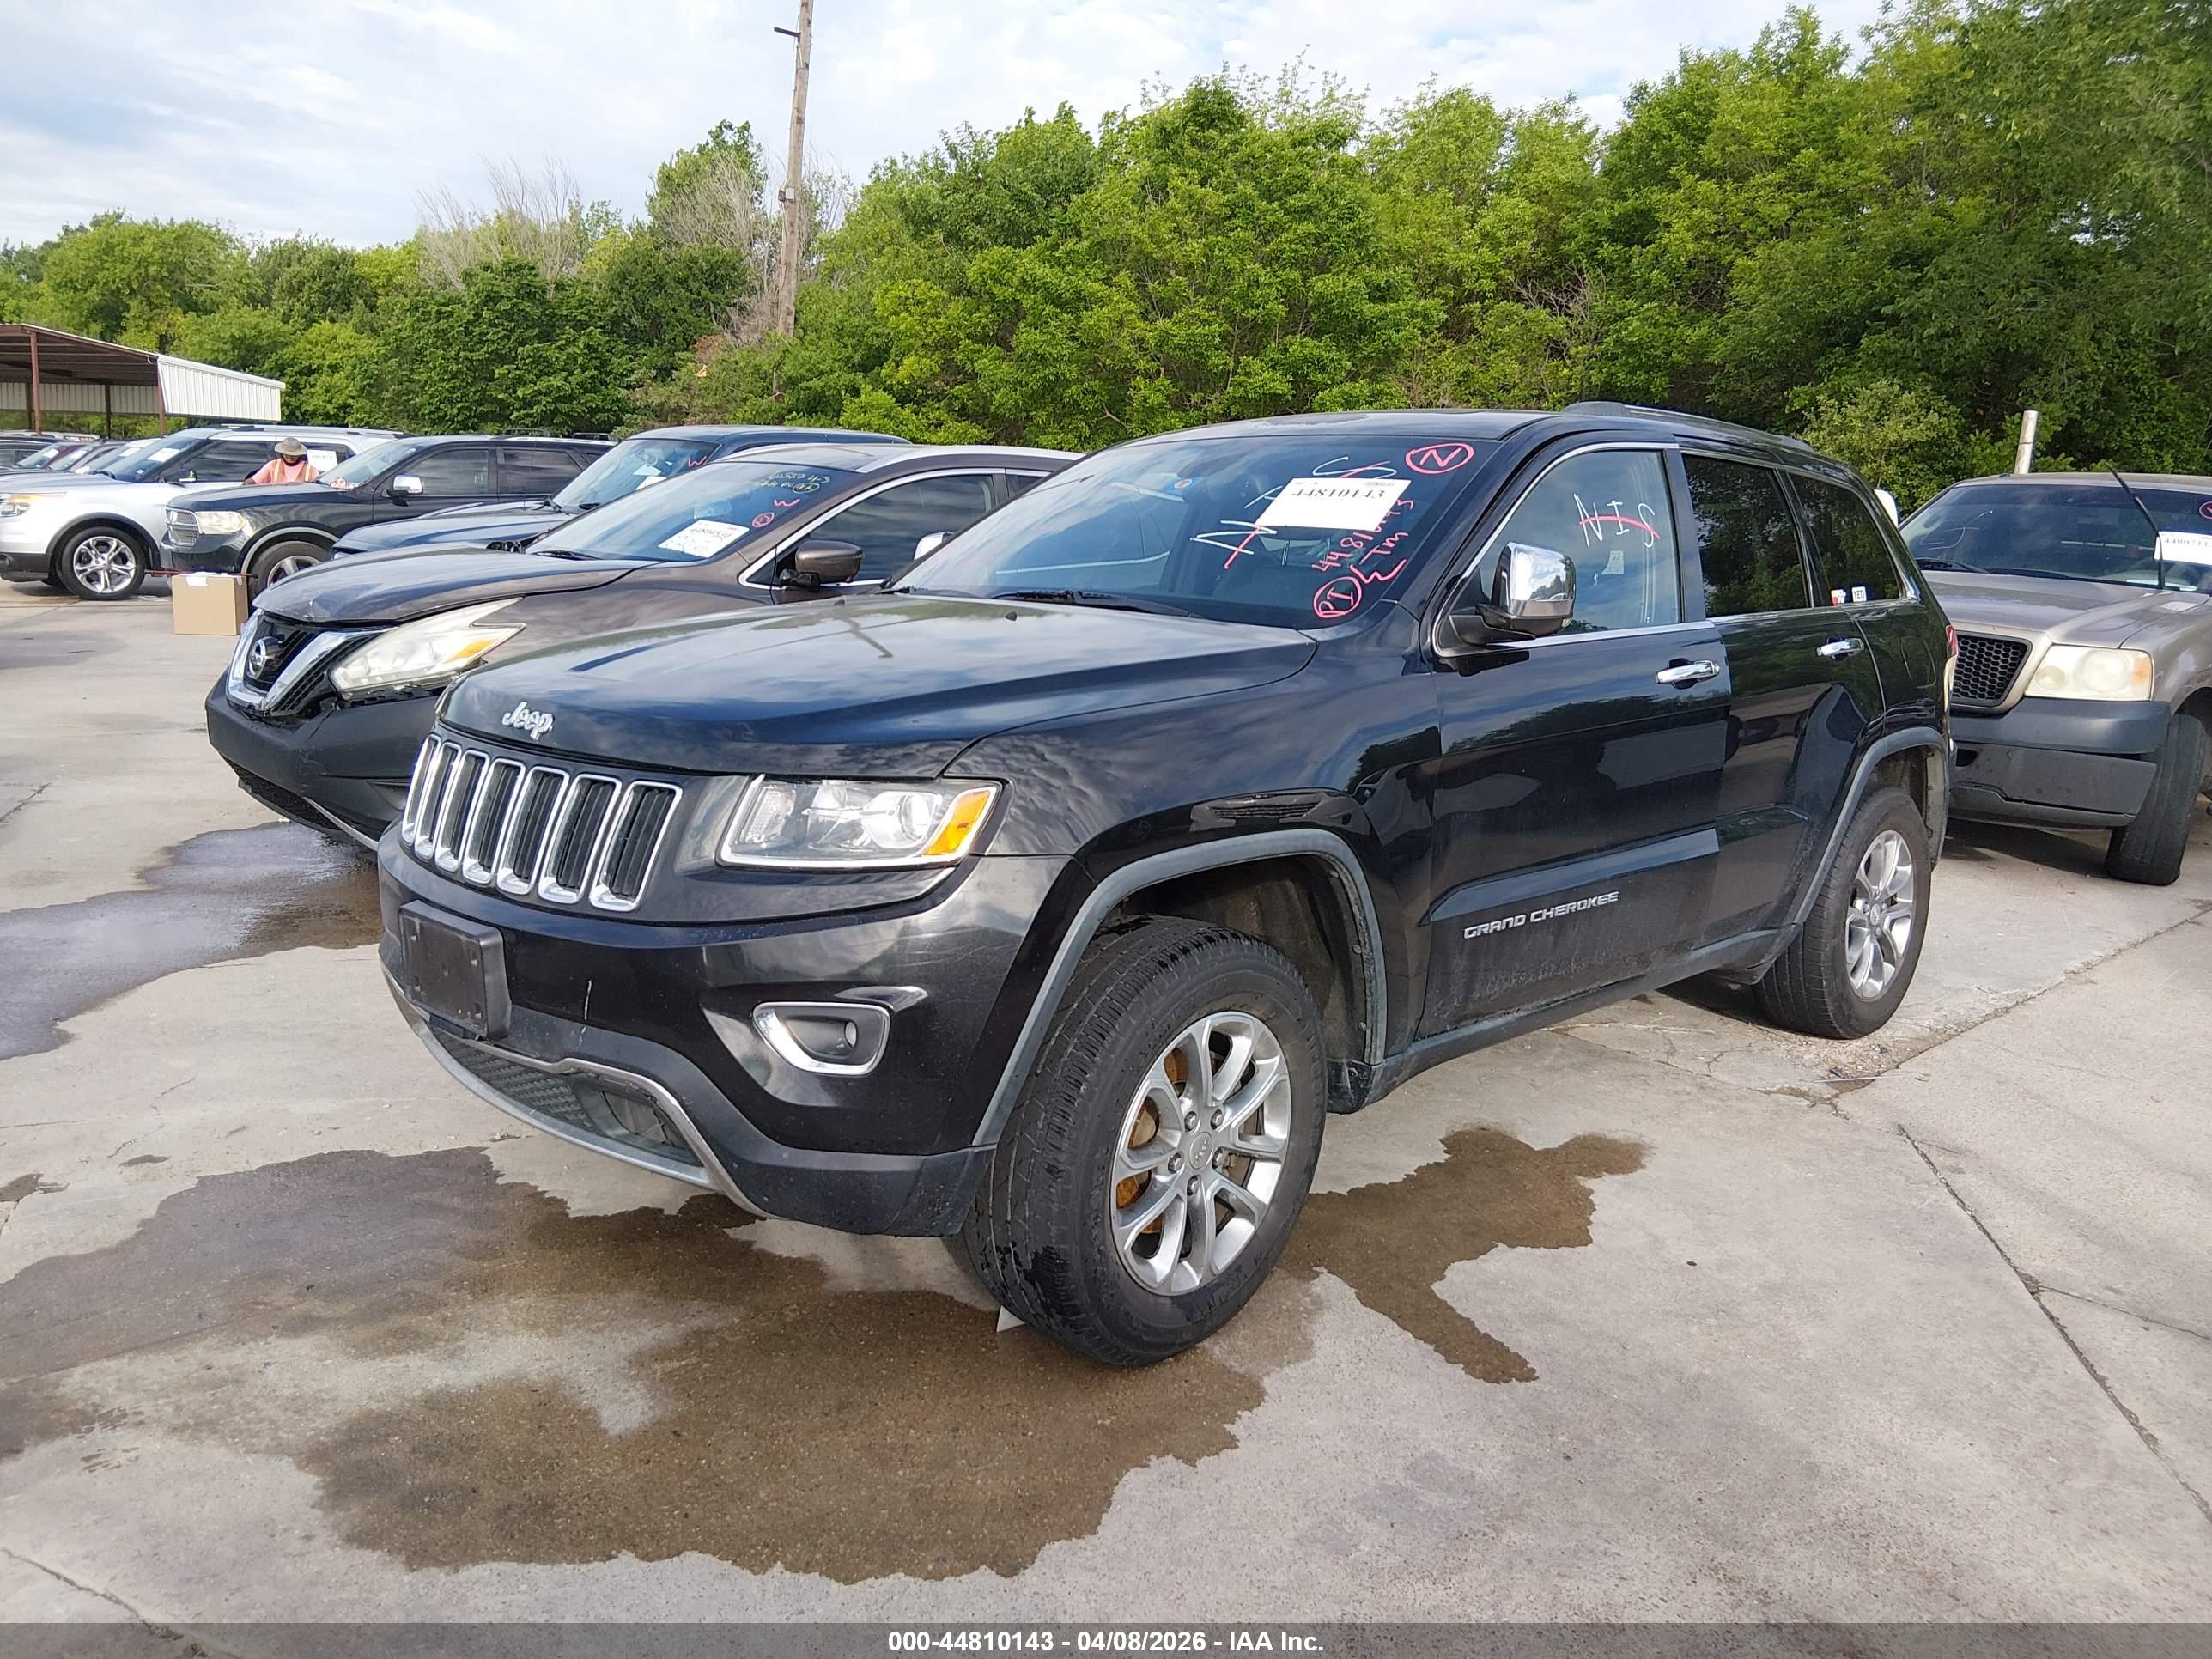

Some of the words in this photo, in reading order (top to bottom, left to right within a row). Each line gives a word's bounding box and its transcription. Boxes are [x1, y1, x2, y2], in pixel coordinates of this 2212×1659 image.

[1573, 493, 1656, 549] NIS
[502, 701, 555, 741] Jeep
[1463, 914, 1526, 939] GRAND
[1530, 891, 1620, 923] CHEROKEE
